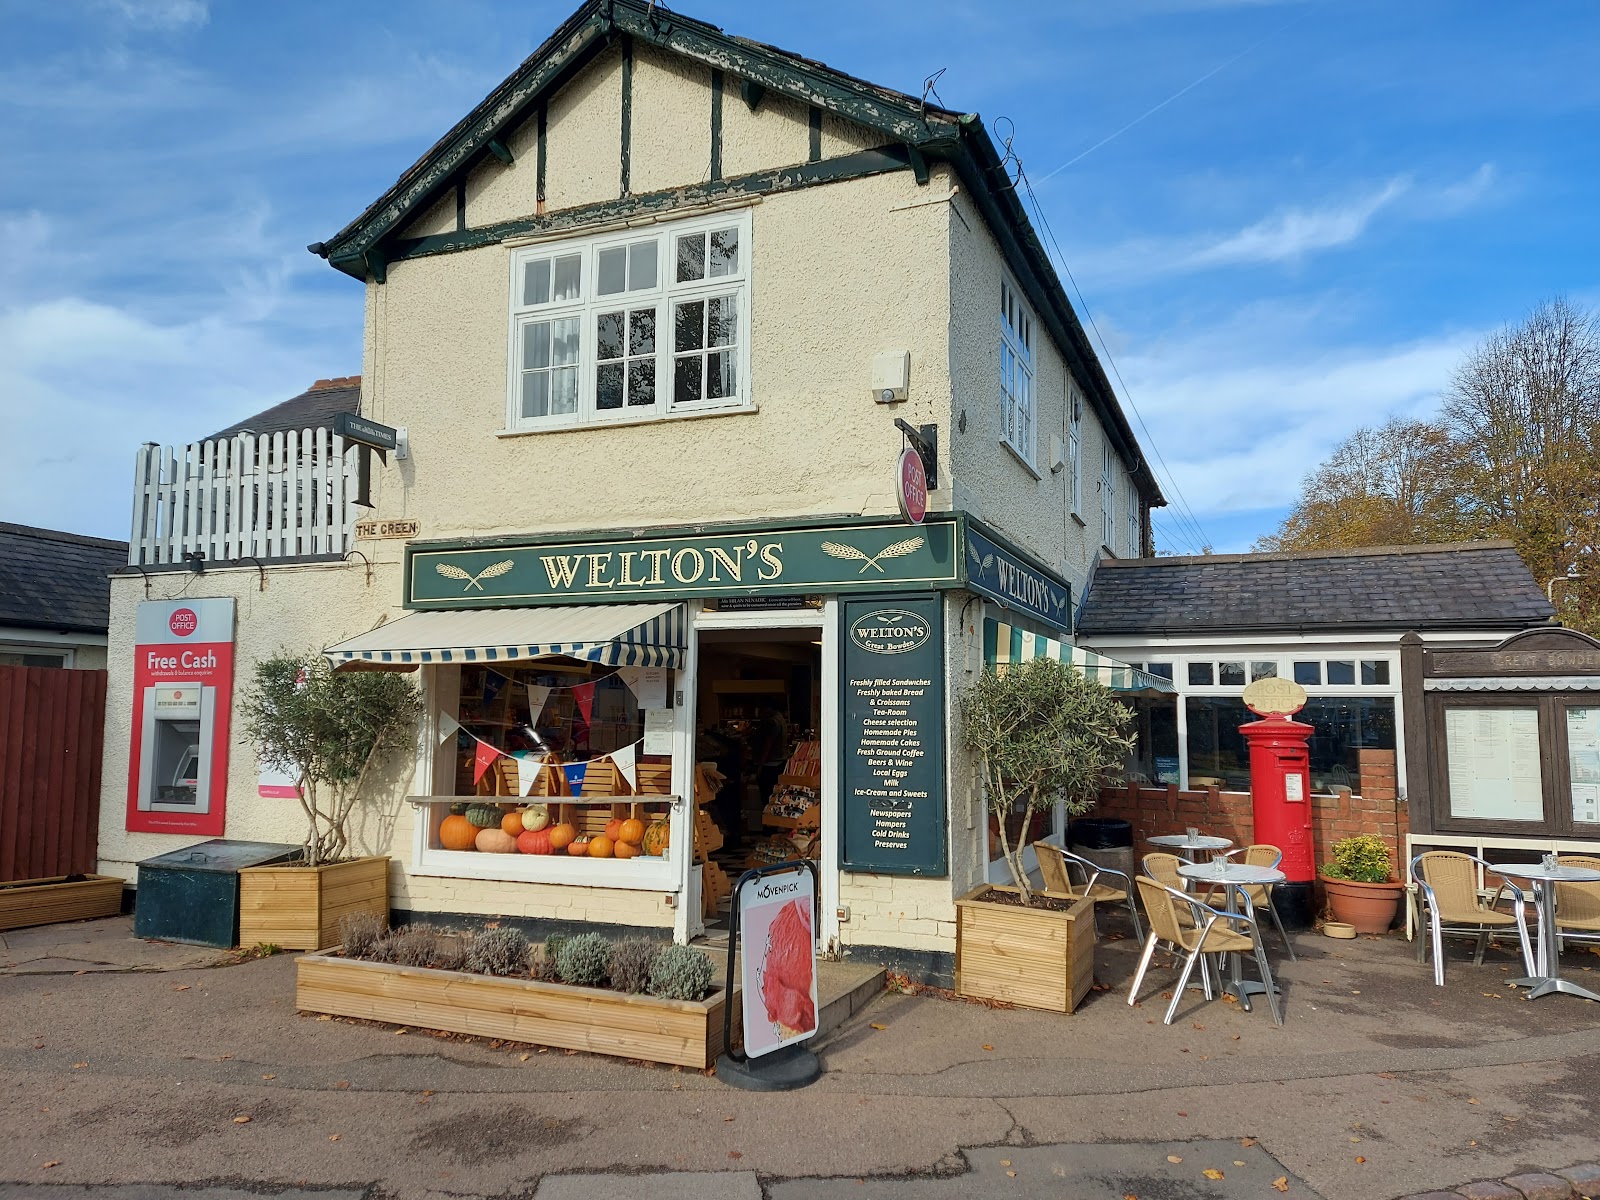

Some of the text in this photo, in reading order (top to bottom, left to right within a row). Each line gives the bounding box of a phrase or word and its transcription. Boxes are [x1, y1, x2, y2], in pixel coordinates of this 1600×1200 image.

[375, 430, 392, 440] TIMES
[908, 463, 921, 486] POST
[905, 480, 924, 508] OFFICE
[356, 522, 416, 535] THE GREEN
[539, 540, 783, 589] WELTON'S
[996, 555, 1049, 613] WELTON'S
[857, 626, 924, 638] WELTON'S
[865, 640, 914, 650] Great Bowden
[147, 649, 217, 669] Free Cash
[1256, 684, 1294, 694] POST
[902, 749, 924, 758] Coffee
[891, 769, 908, 777] Eggs
[854, 788, 888, 797] Ice-Cream
[903, 790, 928, 798] Sweets
[870, 809, 912, 818] Newspapers
[876, 820, 906, 828] Hampers
[888, 830, 910, 838] Drinks
[875, 840, 907, 849] Preserves
